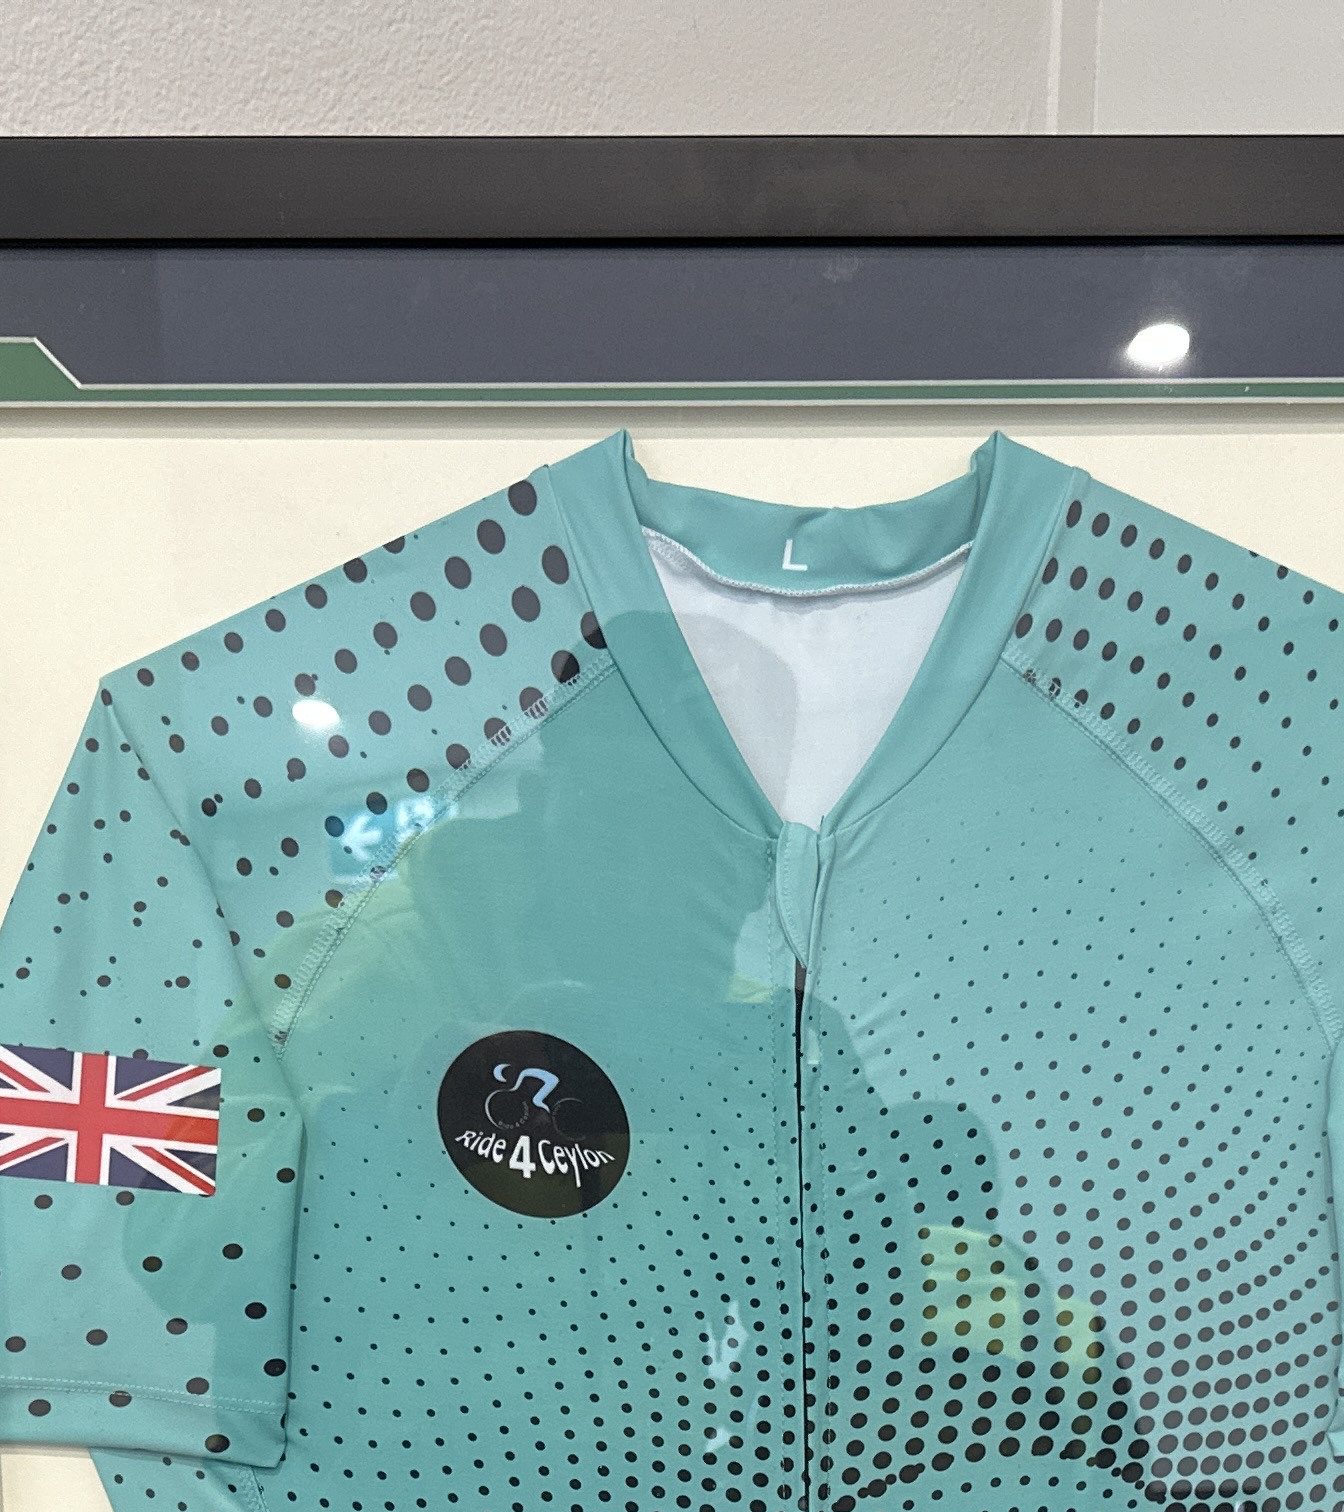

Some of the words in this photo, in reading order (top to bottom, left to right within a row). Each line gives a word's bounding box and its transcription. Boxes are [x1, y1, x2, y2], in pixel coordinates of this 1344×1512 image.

[782, 538, 808, 571] L
[455, 1130, 507, 1163] Ride
[509, 1135, 536, 1179] 4
[538, 1139, 616, 1188] Ceylon
